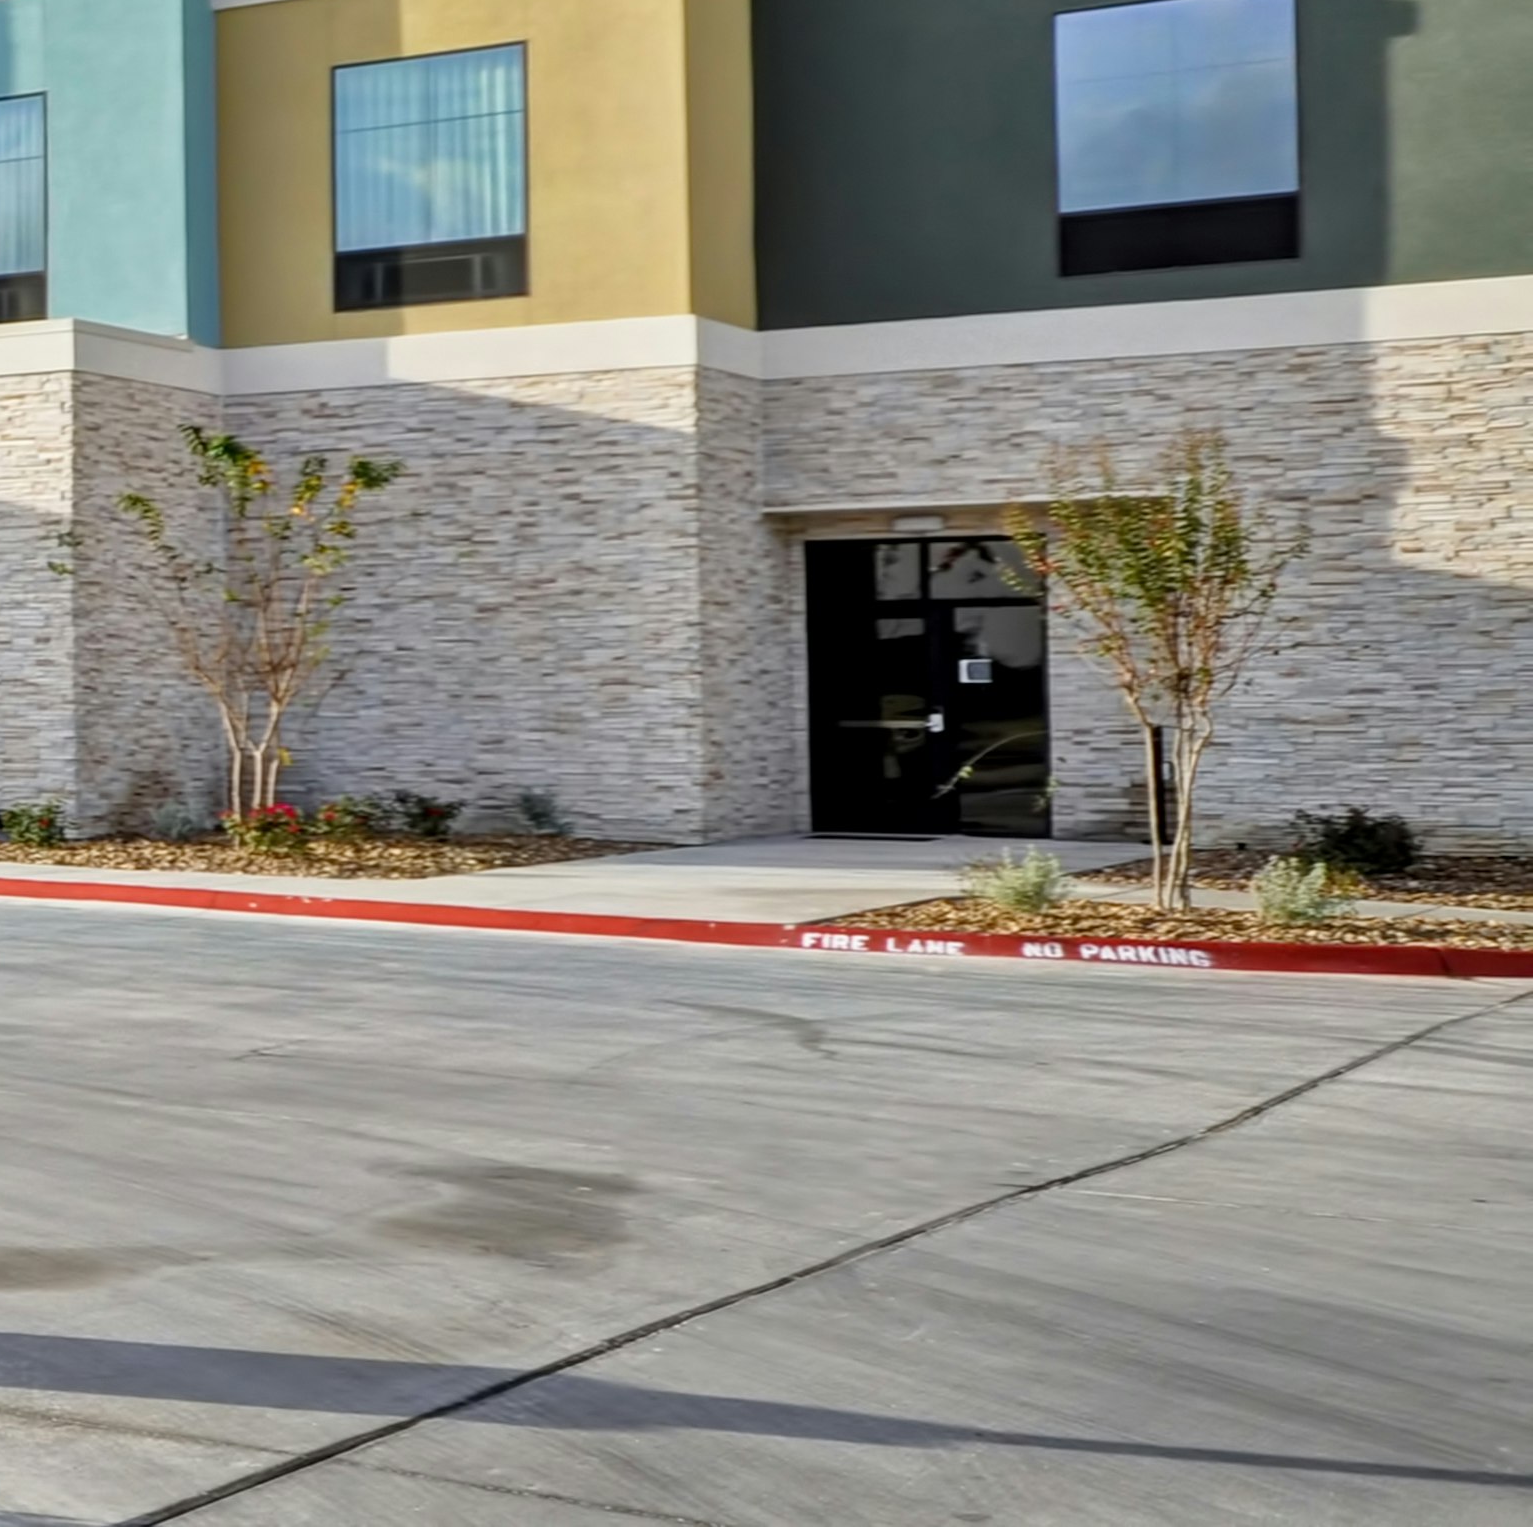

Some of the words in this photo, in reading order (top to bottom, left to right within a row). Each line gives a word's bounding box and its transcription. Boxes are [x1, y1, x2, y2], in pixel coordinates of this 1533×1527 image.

[801, 932, 870, 951] FIRE
[886, 937, 965, 956] LANE
[1022, 942, 1064, 958] NO
[1080, 943, 1211, 967] PARKING
